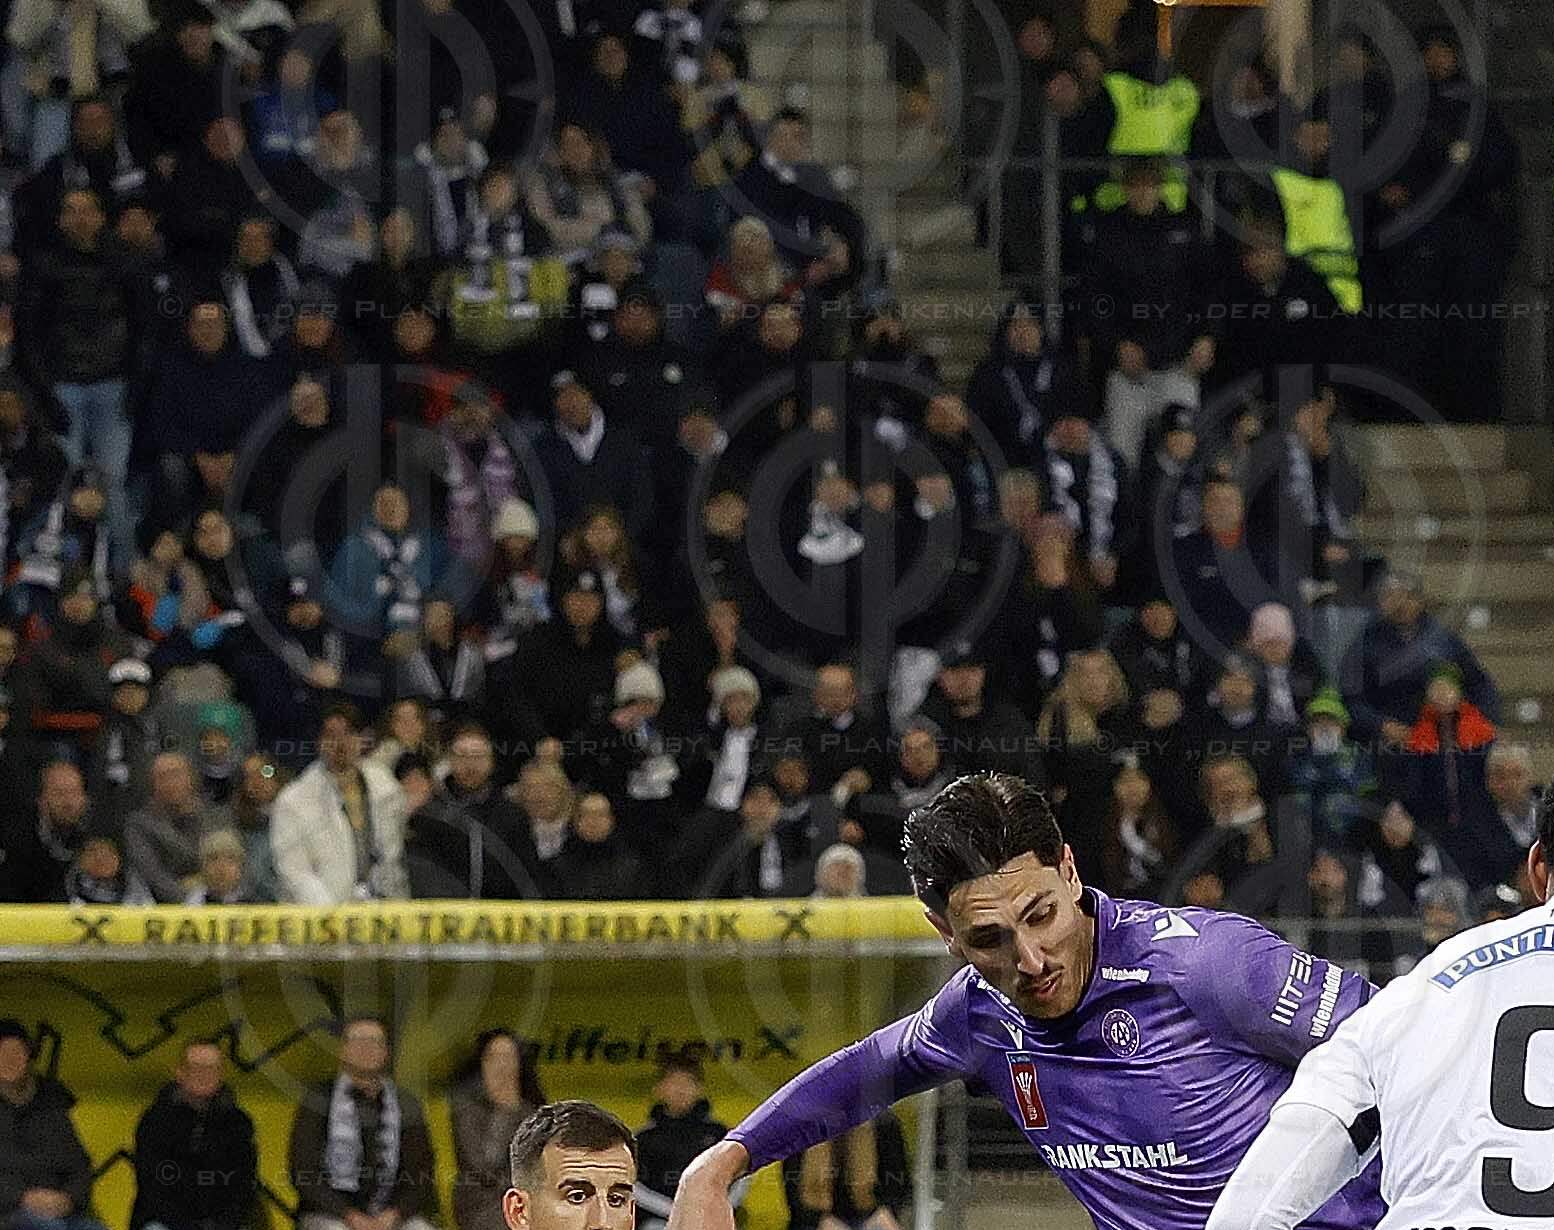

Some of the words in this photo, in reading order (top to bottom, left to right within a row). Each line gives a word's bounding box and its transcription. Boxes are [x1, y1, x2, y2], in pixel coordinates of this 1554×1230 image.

[144, 914, 401, 945] RAIFFEISEN
[418, 912, 742, 944] TRAINERBANK
[530, 1026, 745, 1063] aiffeisen
